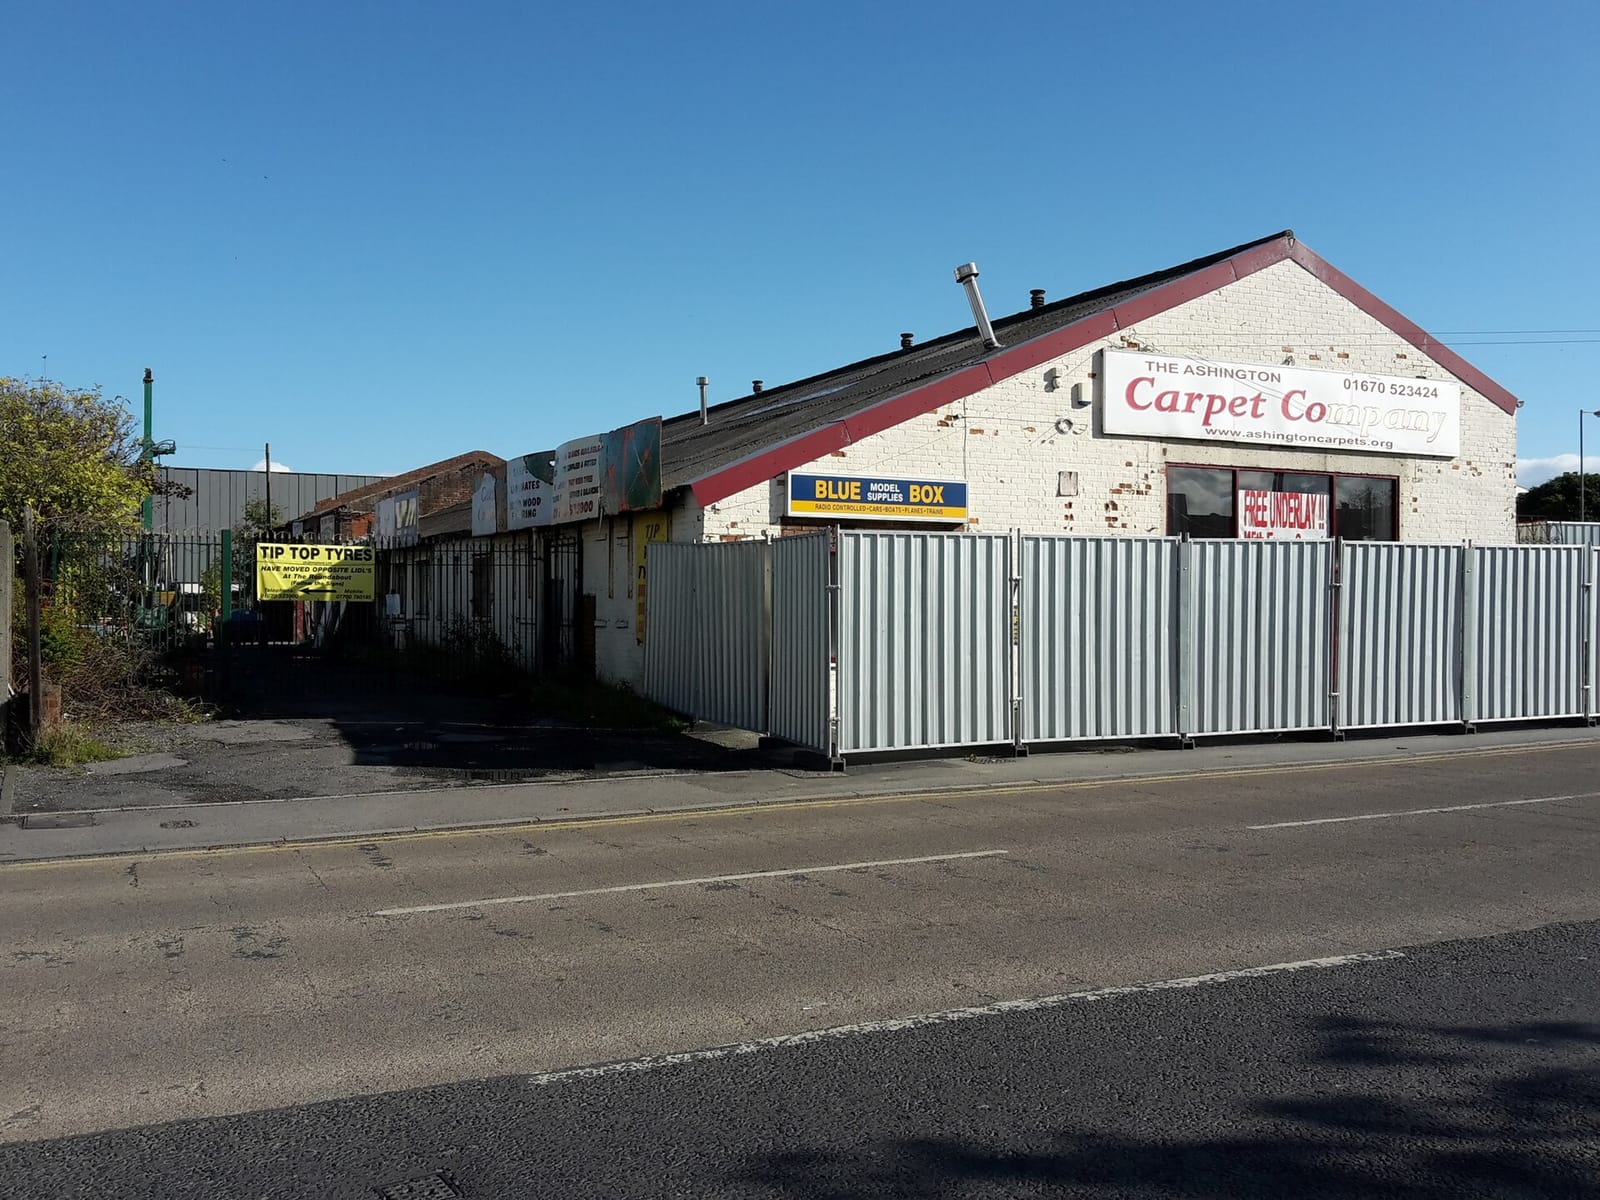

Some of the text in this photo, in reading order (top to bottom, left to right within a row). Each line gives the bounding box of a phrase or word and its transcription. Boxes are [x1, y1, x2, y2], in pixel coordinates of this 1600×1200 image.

[1145, 361, 1281, 383] THE ASHINGTON
[1343, 378, 1438, 399] 01670 523424
[1125, 376, 1447, 444] Carpet Company
[1205, 428, 1393, 449] www.ashingtoncarpets.org
[815, 480, 944, 504] BLUE MODEL BOX
[867, 492, 903, 502] SUPPLIES
[815, 503, 831, 511] RADIO
[1244, 490, 1268, 527] FREE
[645, 524, 660, 539] TIP
[260, 546, 372, 561] TIP TOP TYRES
